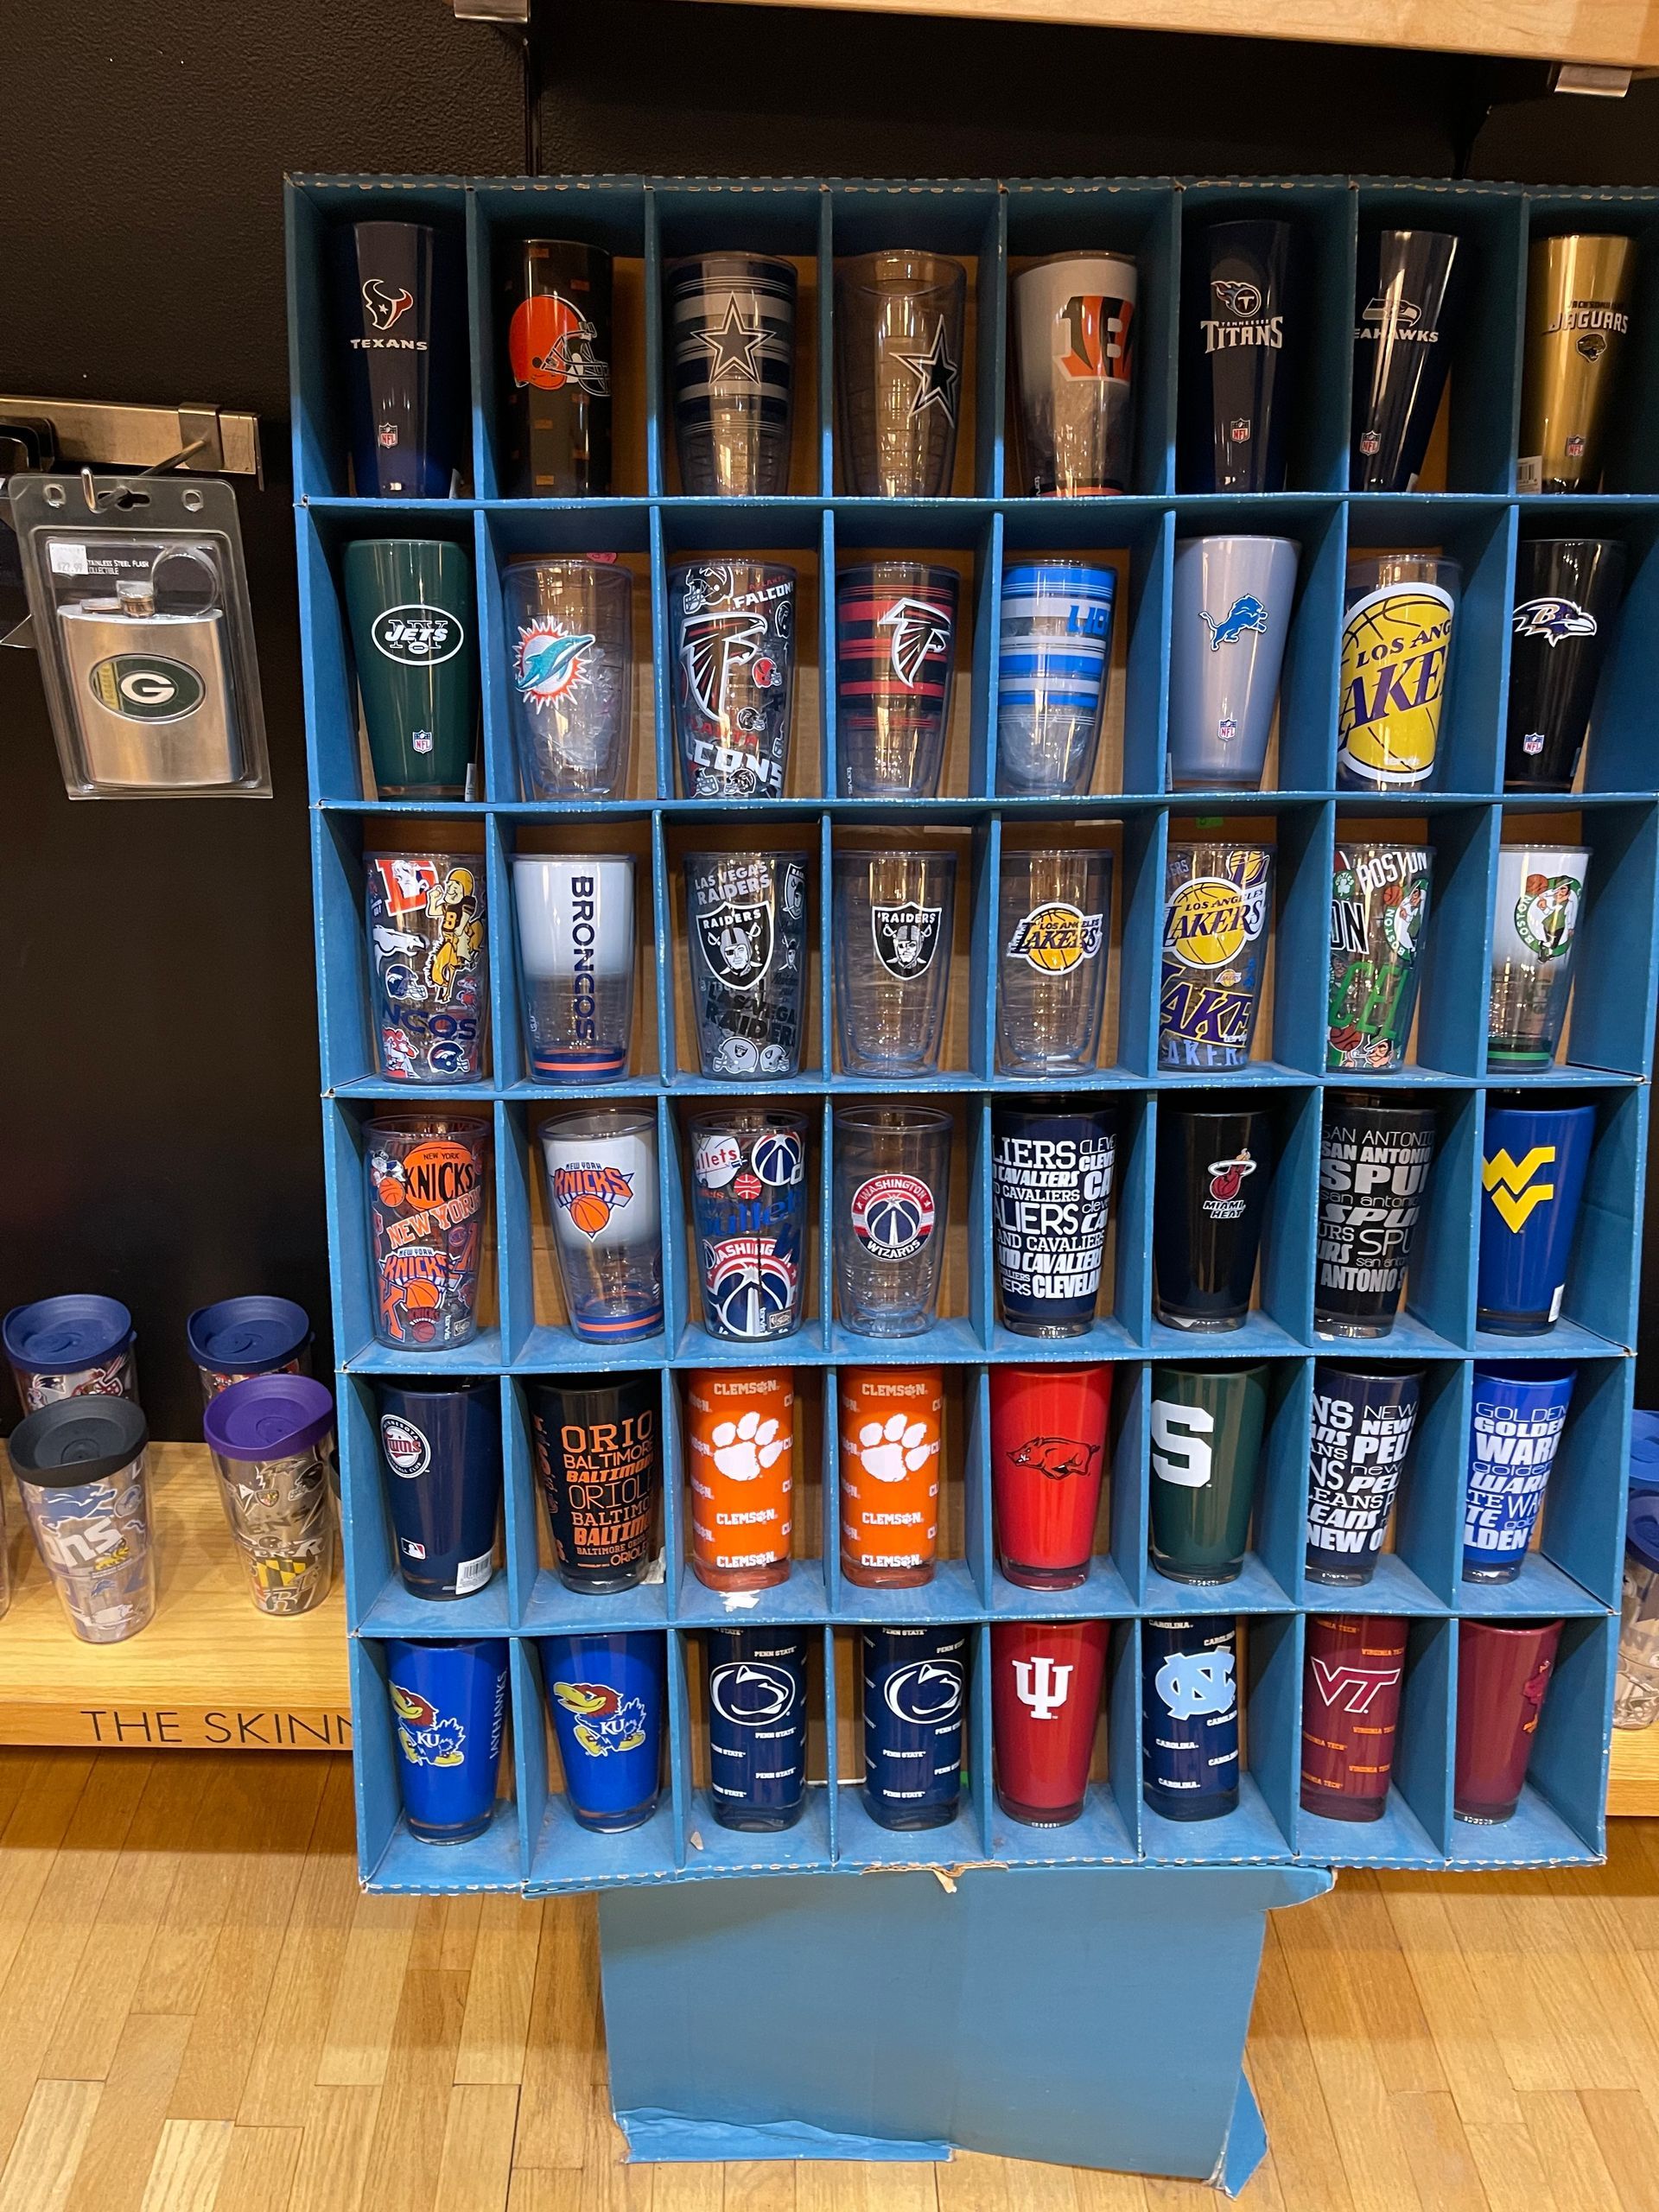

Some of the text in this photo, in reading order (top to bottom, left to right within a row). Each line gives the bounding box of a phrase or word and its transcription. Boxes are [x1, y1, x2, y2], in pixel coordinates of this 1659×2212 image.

[1541, 309, 1630, 335] JAGUARS
[1200, 315, 1284, 354] TITANS
[350, 338, 429, 351] TEXANS
[380, 433, 397, 444] NFL
[1233, 428, 1249, 440] NFL
[1363, 440, 1380, 453] NFL
[733, 581, 794, 609] FALCON
[1534, 605, 1557, 624] B
[385, 624, 449, 642] JETS
[1356, 637, 1405, 669] LOS
[121, 673, 175, 704] G
[1220, 726, 1236, 737] NFL
[415, 740, 430, 749] NFL
[1526, 741, 1541, 753] NFL
[694, 861, 768, 891] LAS VEGAS
[1357, 851, 1427, 896] BOSTON
[696, 874, 772, 906] RAIDERS
[1185, 887, 1265, 912] LOS ANGELES
[702, 908, 761, 930] RAIDERS
[881, 912, 936, 925] RAIDERS
[1039, 918, 1100, 931] LOS ANGELES
[1163, 899, 1264, 948] LAKERS
[1515, 893, 1535, 946] BOSTON
[1009, 921, 1101, 957] LAKERS
[1384, 908, 1406, 956] BOSTON
[570, 876, 596, 1040] BRONCOS
[1362, 1129, 1434, 1147] ANTONIO
[1321, 1142, 1432, 1165] SAN ANTONIO
[566, 1162, 602, 1171] NEW YORK
[404, 1160, 474, 1203] KNICKS
[554, 1167, 632, 1200] KNICKS
[999, 1168, 1080, 1188] CAVALIERS
[861, 1179, 927, 1202] WASHINGTON
[1002, 1187, 1080, 1203] CAVALIERS
[1321, 1189, 1354, 1206] san
[1203, 1199, 1246, 1211] MIAMI
[1210, 1208, 1244, 1219] HEAT
[386, 1208, 431, 1250] NEW
[430, 1185, 481, 1231] YORK
[867, 1238, 922, 1259] WIZARDS
[997, 1230, 1105, 1253] AND CAVALIERS
[398, 1248, 434, 1256] NEW YORK
[1356, 1257, 1382, 1268] san
[1320, 1262, 1399, 1293] ANTONIO
[1363, 1401, 1417, 1421] NEW
[1476, 1402, 1567, 1424] GOLDEN
[562, 1409, 653, 1453] ORIO
[1361, 1416, 1416, 1436] NEW
[385, 1432, 423, 1459] Twins
[1151, 1399, 1214, 1488] S
[576, 1542, 626, 1555] BALTIMORE
[1306, 1524, 1368, 1554] NEW
[775, 1645, 797, 1656] STATE
[937, 1644, 954, 1654] PENN
[1362, 1648, 1392, 1656] VIRGINIA
[1311, 1656, 1402, 1713] VT
[80, 1711, 183, 1743] THE
[600, 1719, 626, 1735] KU
[775, 1727, 797, 1738] STATE
[935, 1726, 952, 1735] PENN
[416, 1731, 441, 1749] KU
[1156, 1738, 1197, 1750] CAROLINA
[883, 1749, 926, 1758] PENN STATE
[775, 1767, 796, 1778] STATE
[934, 1766, 951, 1776] PENN
[1158, 1777, 1198, 1789] CAROLINA
[883, 1789, 926, 1799] PENN STATE
